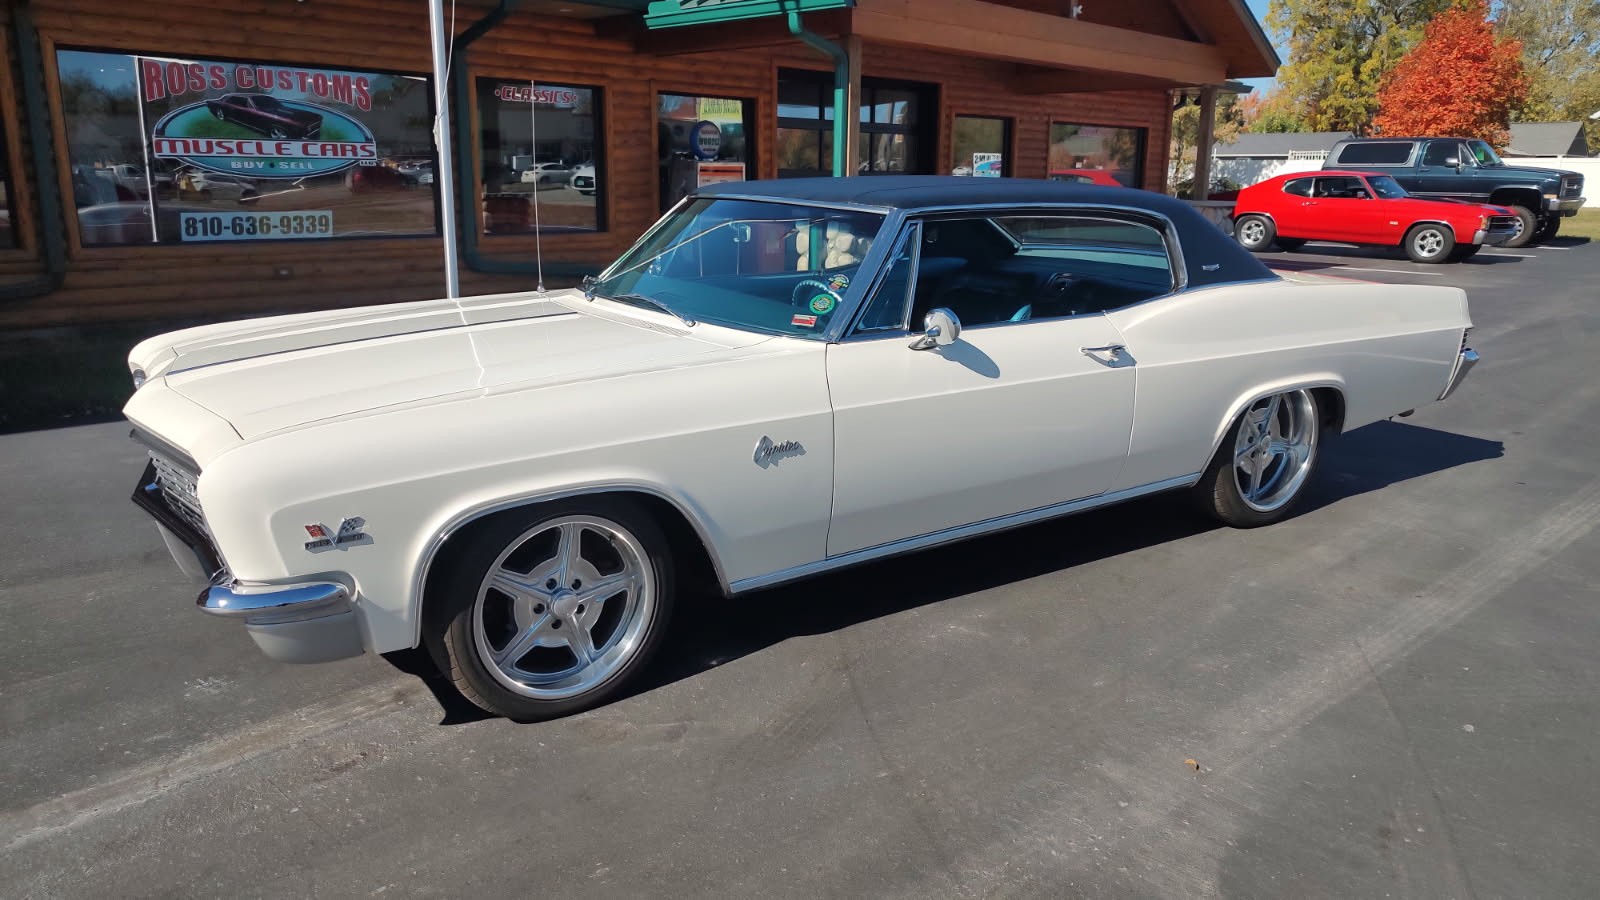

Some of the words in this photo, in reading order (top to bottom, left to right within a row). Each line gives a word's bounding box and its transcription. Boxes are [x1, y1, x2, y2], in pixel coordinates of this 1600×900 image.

[142, 60, 227, 102] ROSS
[235, 66, 372, 111] CUSTOMS
[501, 86, 573, 104] CLASSICS
[155, 139, 291, 155] MUSCLE
[301, 142, 376, 158] CARS
[231, 161, 264, 169] BUY
[279, 161, 315, 170] SELL
[184, 215, 330, 237] 810-636-9339
